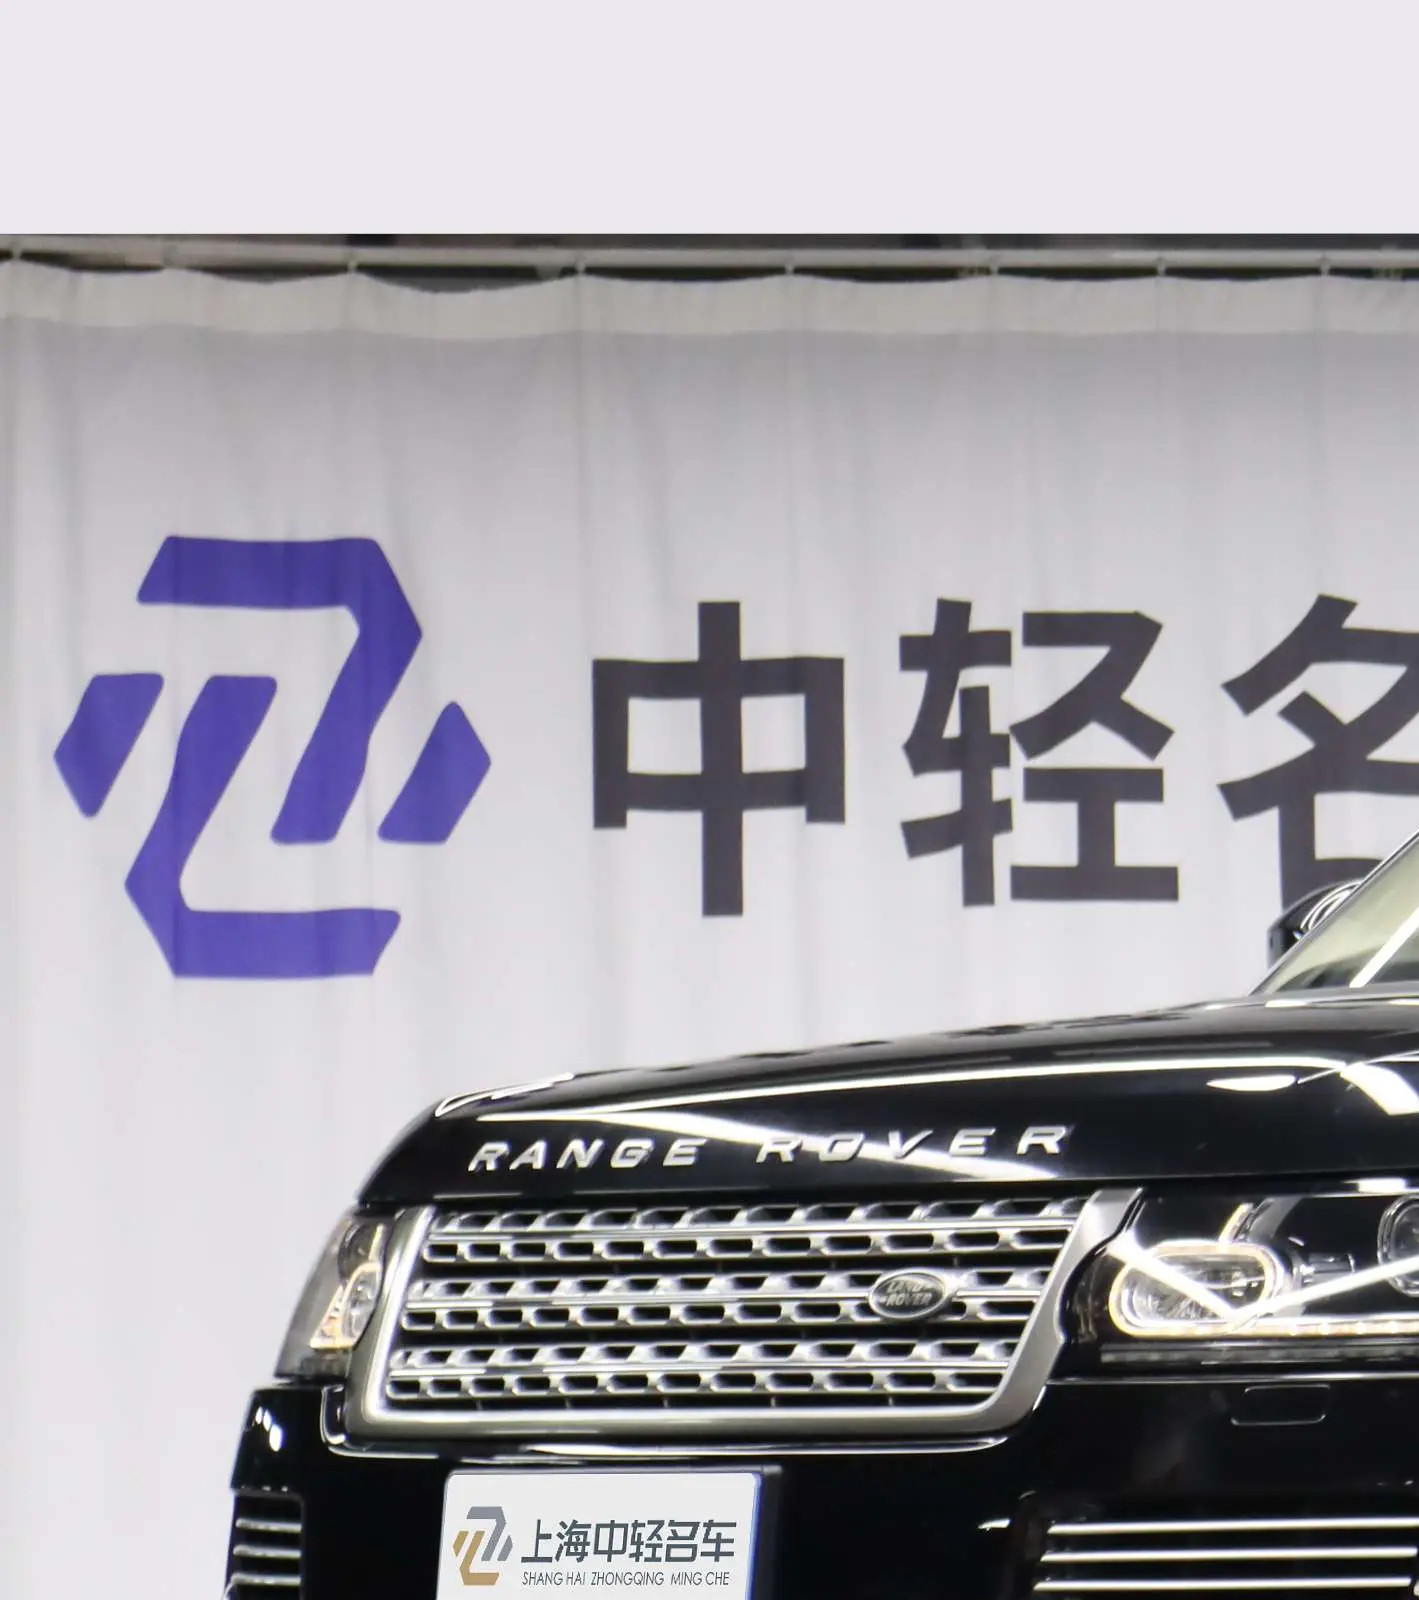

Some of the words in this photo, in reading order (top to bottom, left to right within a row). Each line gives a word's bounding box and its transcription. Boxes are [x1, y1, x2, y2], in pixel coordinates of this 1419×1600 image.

[467, 1137, 706, 1173] RANGE
[755, 1125, 1072, 1166] ROVER
[520, 1518, 738, 1564] 上海中轻名车
[521, 1571, 563, 1586] SHANG
[566, 1571, 586, 1586] HAI
[590, 1571, 665, 1586] ZHONGQING
[670, 1571, 703, 1586] MING
[705, 1571, 731, 1586] CHE
